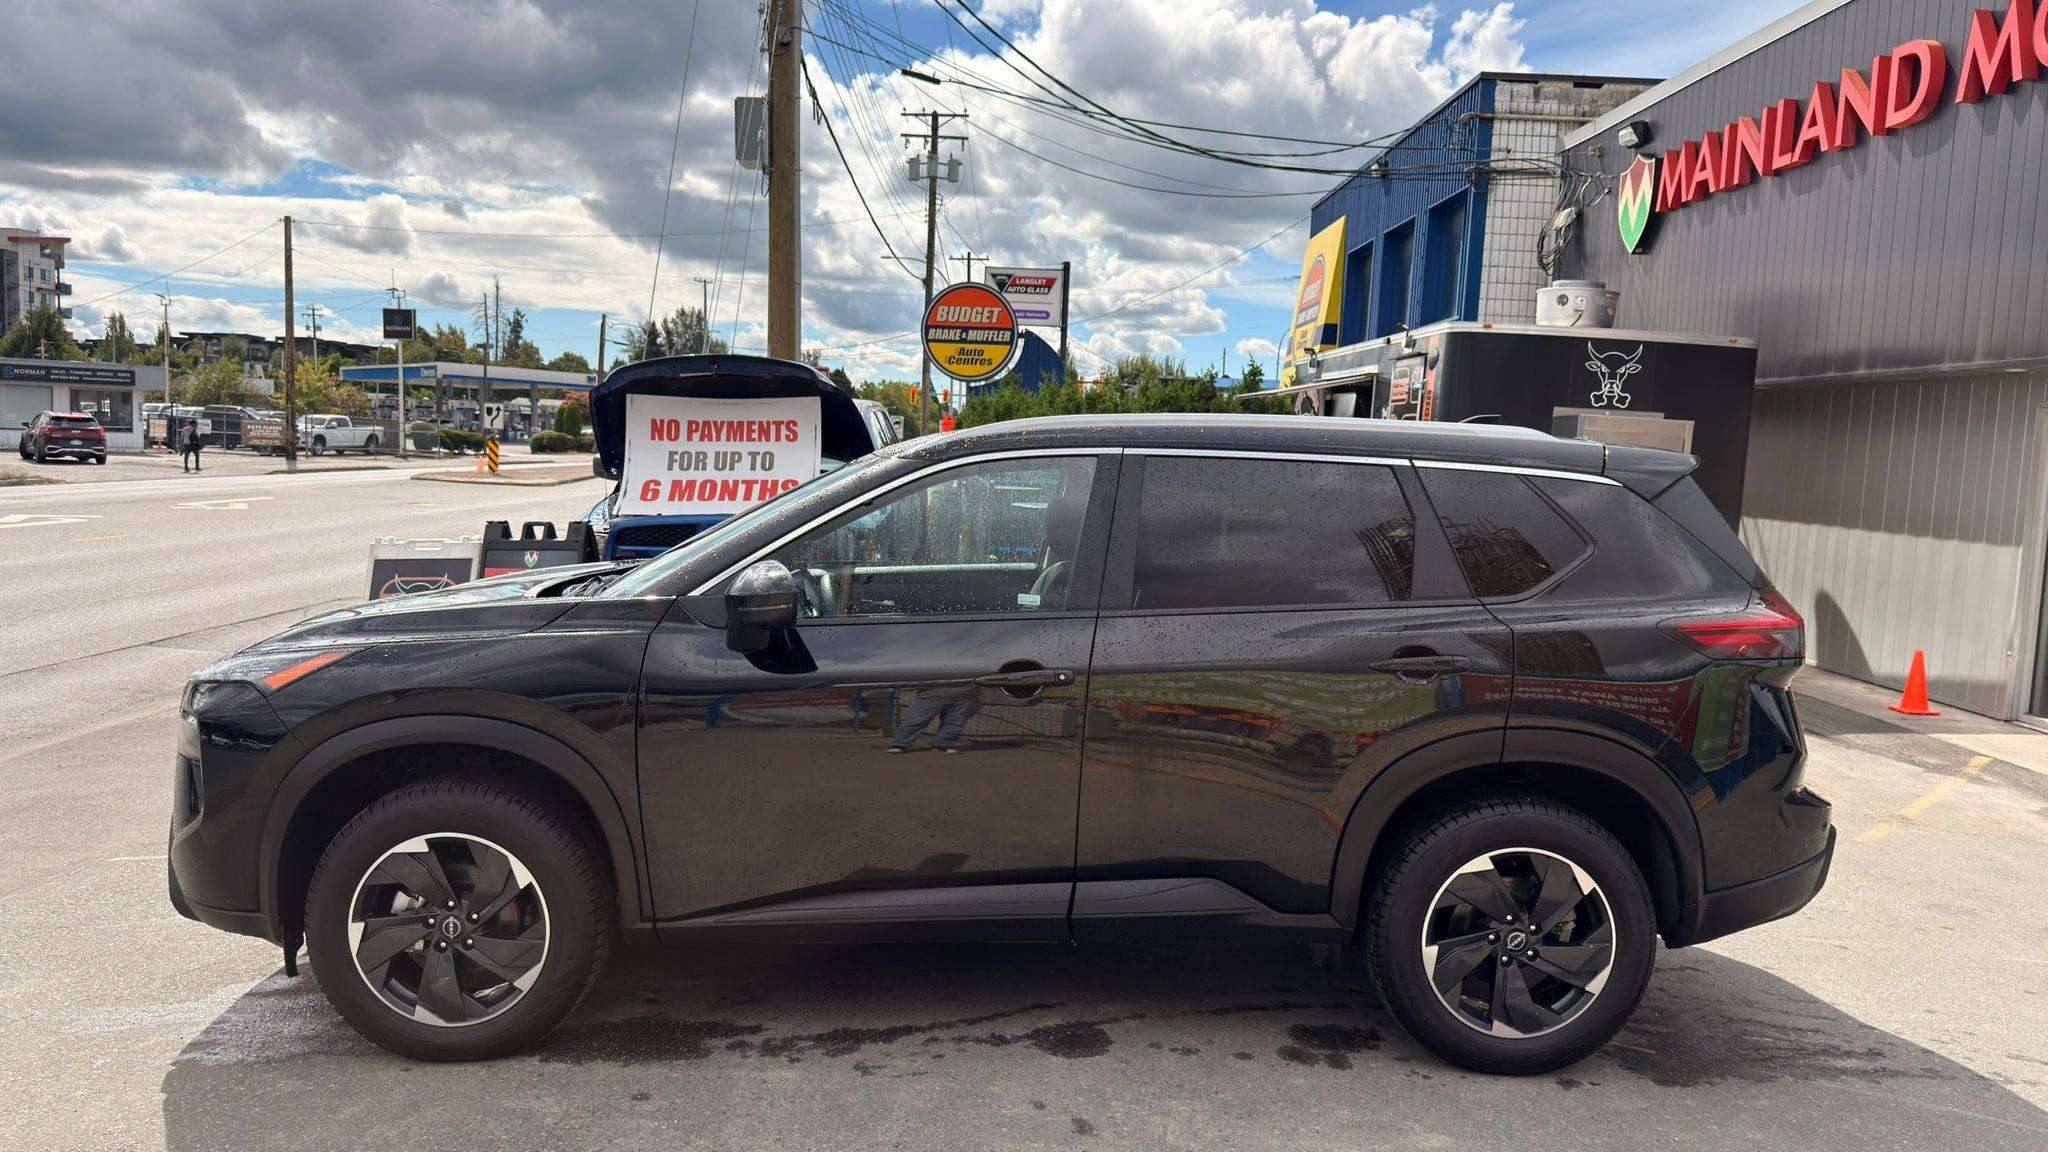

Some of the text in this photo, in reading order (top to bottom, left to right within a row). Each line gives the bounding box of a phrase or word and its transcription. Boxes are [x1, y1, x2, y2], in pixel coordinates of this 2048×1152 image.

[1655, 38, 1946, 213] MAINLAND
[935, 306, 1002, 324] BUDGET
[928, 328, 962, 341] BRAKE
[968, 328, 1011, 342] MUFFLER
[948, 355, 993, 366] Centres
[956, 346, 984, 357] Auto
[13, 368, 46, 376] NORMAN
[650, 418, 799, 443] NO PAYMENTS
[666, 450, 775, 472] FOR UP TO
[639, 479, 800, 502] 6 MONTHS
